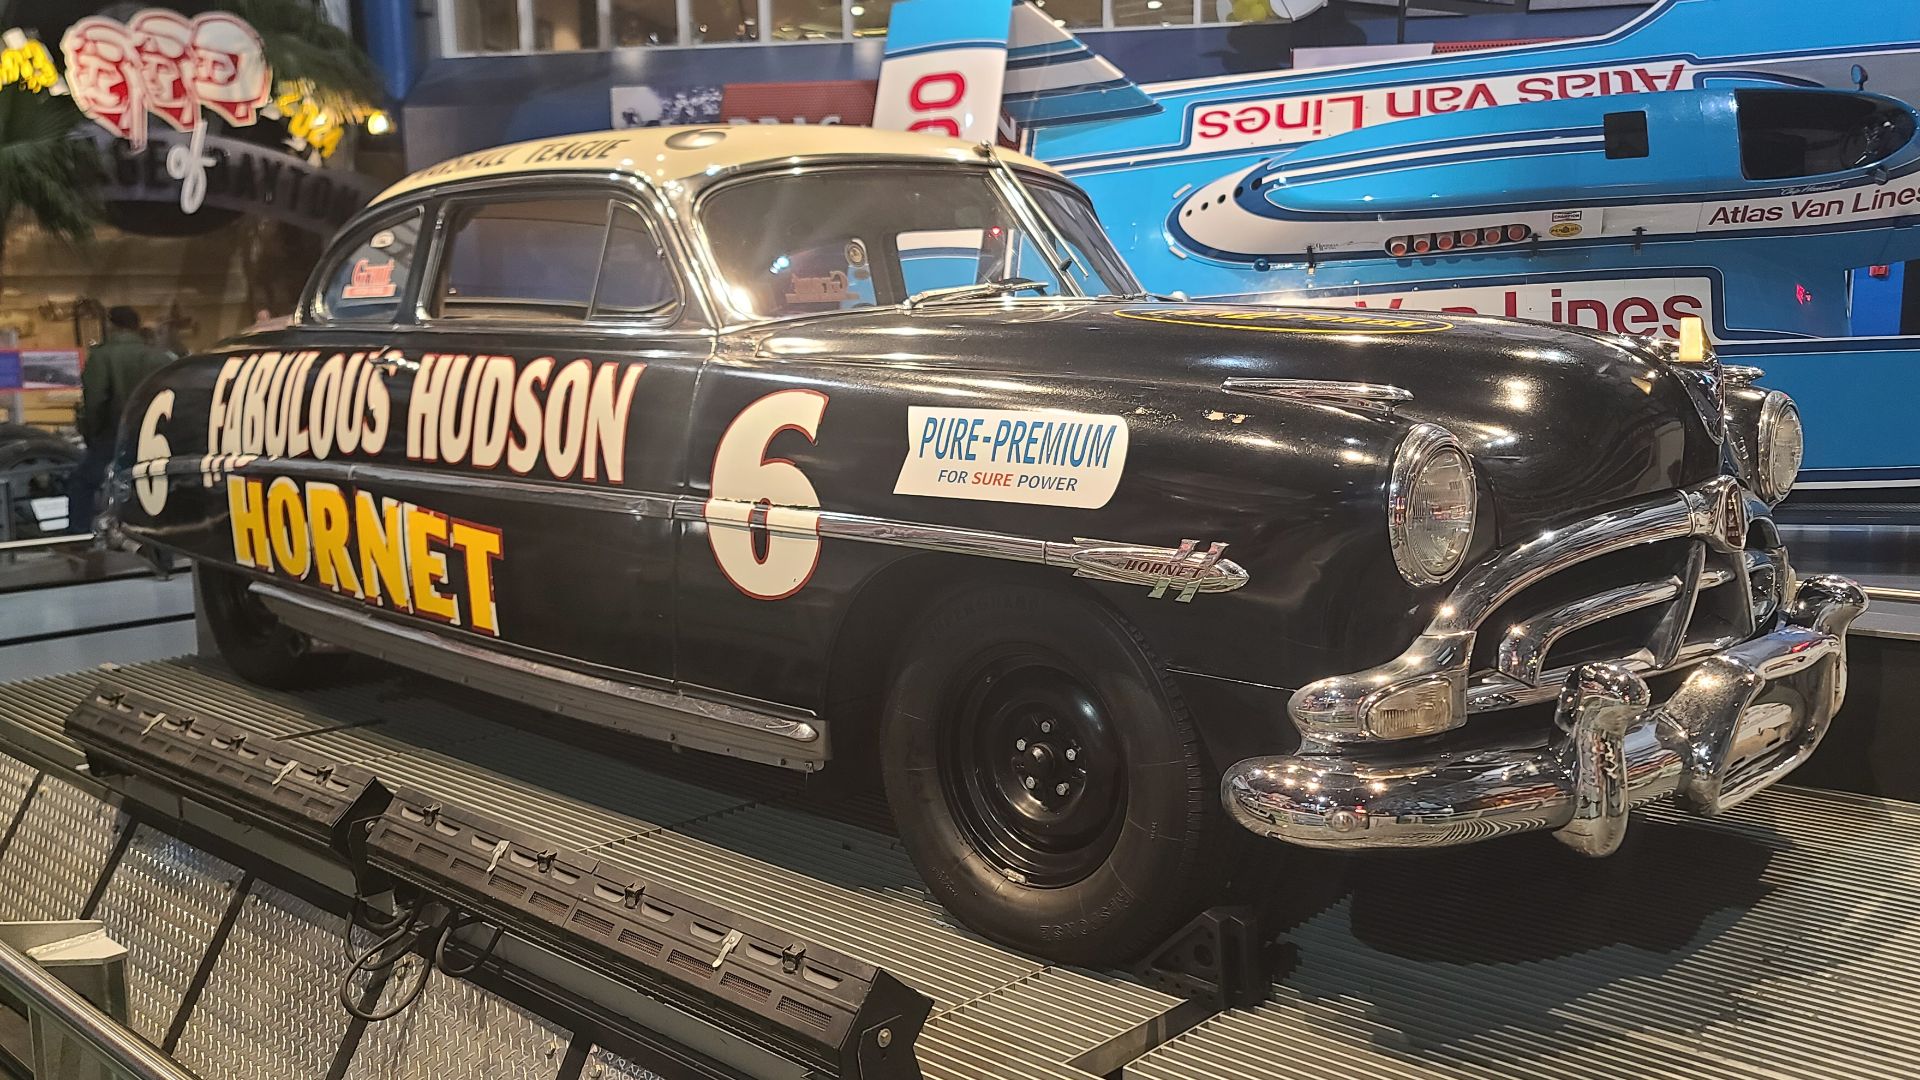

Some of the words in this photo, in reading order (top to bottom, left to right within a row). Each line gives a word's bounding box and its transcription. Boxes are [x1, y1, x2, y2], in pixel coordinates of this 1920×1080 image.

[1386, 83, 1499, 118] Van
[1518, 63, 1686, 104] Atlas
[1198, 95, 1364, 138] Lines
[524, 139, 631, 165] TEAGUE
[1708, 205, 1784, 226] Atlas
[1791, 199, 1844, 220] Van
[200, 351, 403, 488] FABULOUS
[406, 353, 648, 485] HUDSON
[132, 389, 175, 517] 6
[918, 416, 1118, 469] PURE-PREMIUM
[703, 388, 830, 601] 6
[937, 469, 968, 484] FOR
[971, 471, 1014, 487] SURE
[1016, 474, 1078, 492] POWER
[227, 473, 504, 637] HORNET
[1123, 559, 1206, 579] HORNET
